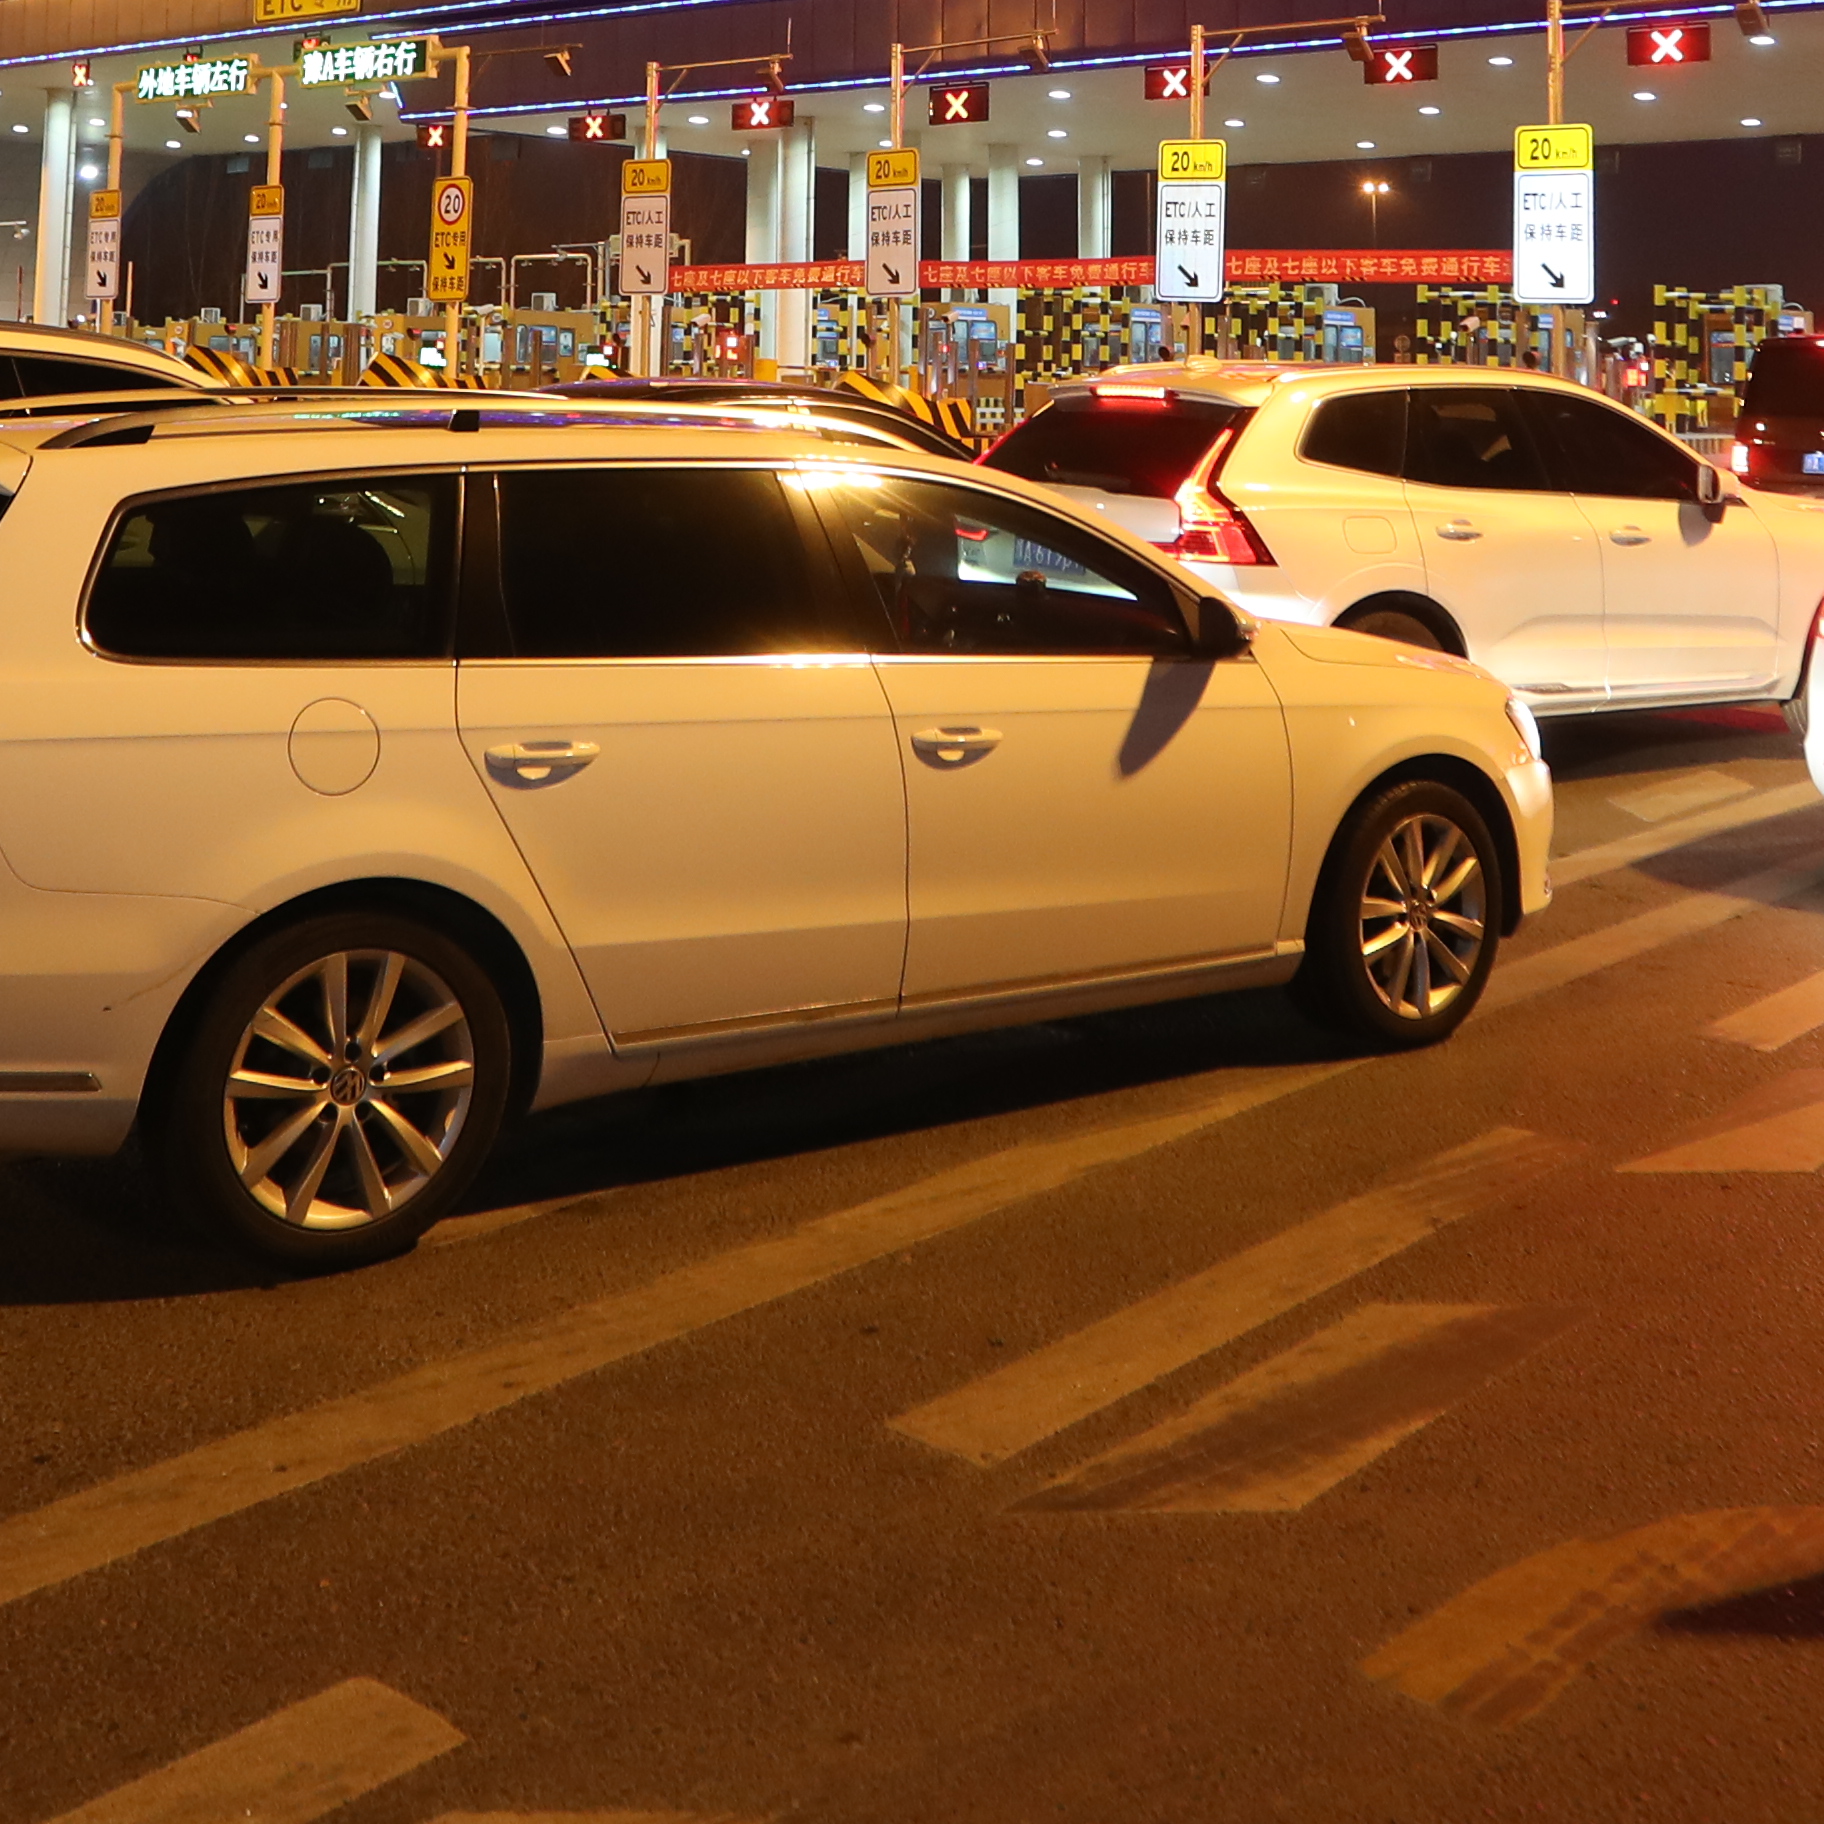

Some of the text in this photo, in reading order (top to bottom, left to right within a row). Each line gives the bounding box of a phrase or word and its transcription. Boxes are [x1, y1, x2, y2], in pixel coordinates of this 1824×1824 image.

[302, 41, 417, 86] 豫A车辆右行
[138, 59, 248, 100] 外地车辆左行
[1530, 137, 1578, 161] 20 km/h
[875, 159, 890, 180] 20
[1171, 151, 1213, 172] 20 km/h
[631, 168, 646, 187] 20
[444, 194, 461, 214] 20
[1165, 201, 1216, 218] ETC/人工
[1523, 192, 1583, 211] ETC/人工
[626, 210, 664, 226] ETC/人工
[871, 203, 912, 222] ETC/人工
[625, 233, 663, 249] 保持车距
[870, 229, 912, 247] 保持车距
[1164, 229, 1215, 246] 保持车距
[1524, 223, 1584, 242] 保持车距
